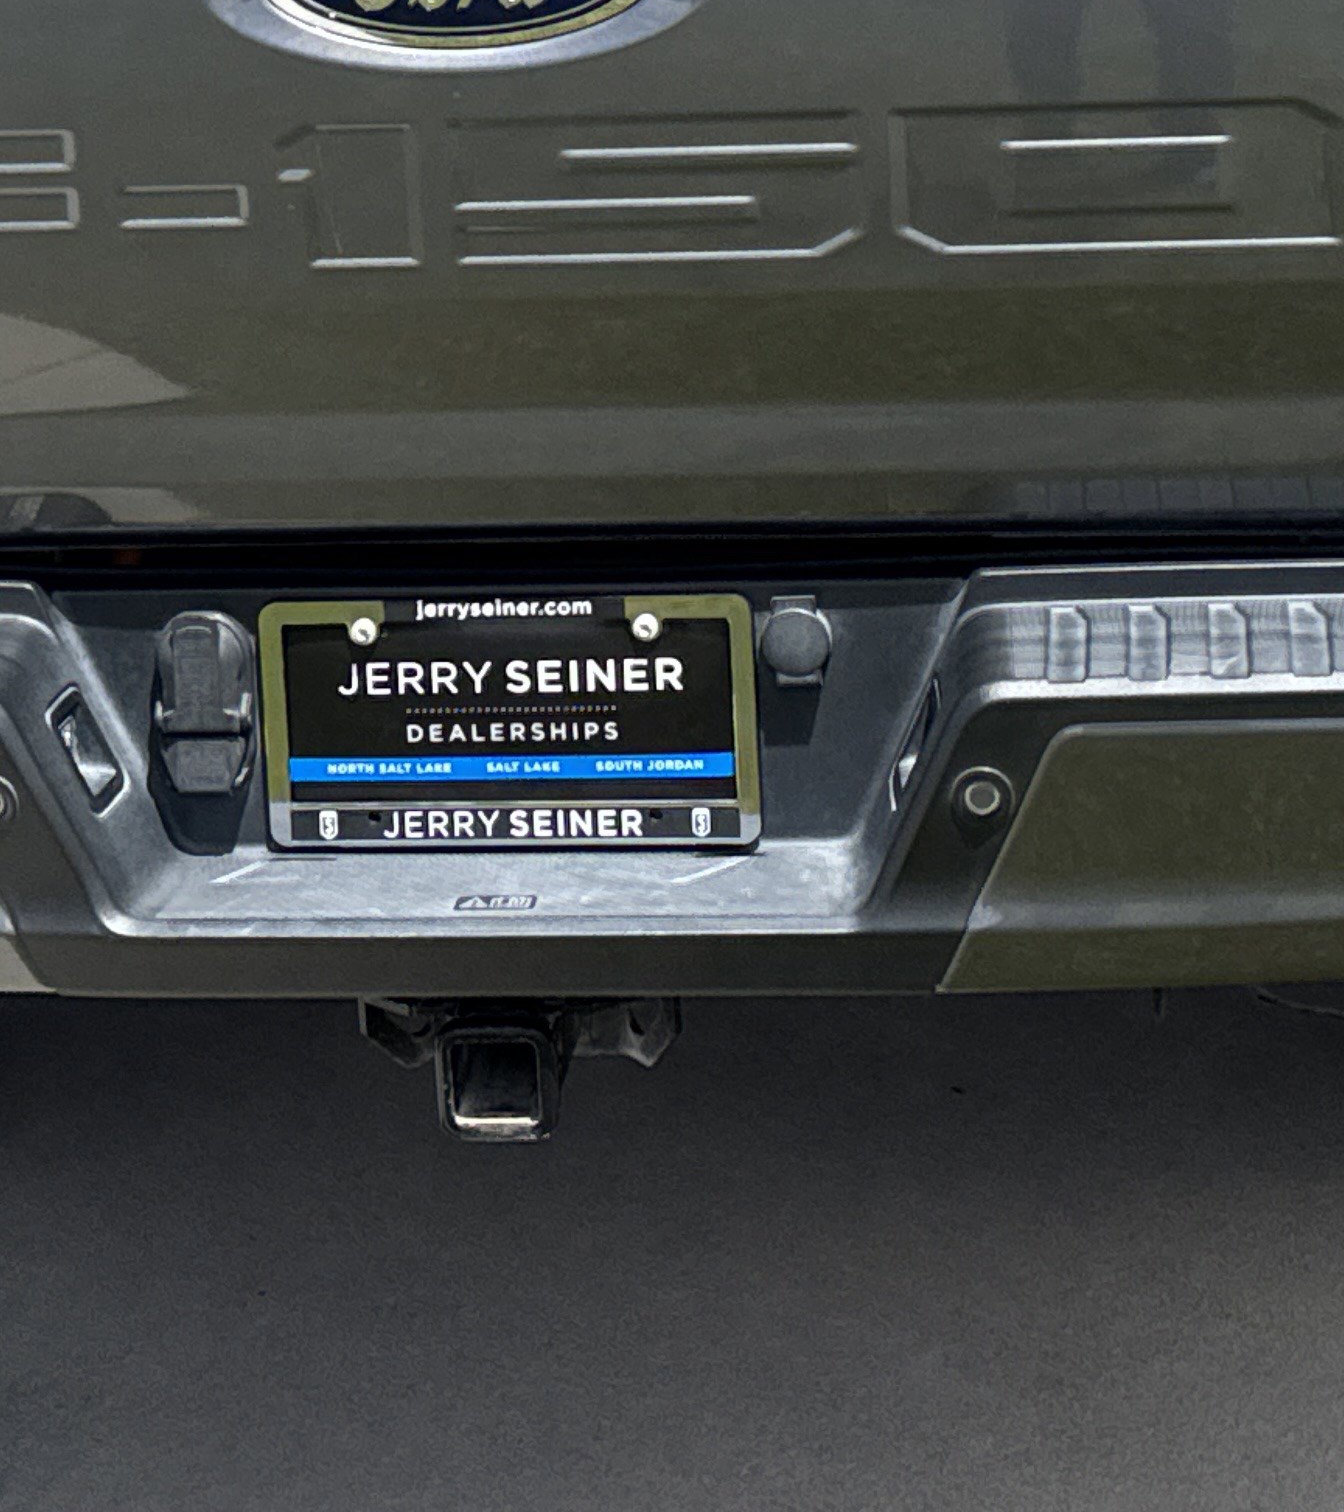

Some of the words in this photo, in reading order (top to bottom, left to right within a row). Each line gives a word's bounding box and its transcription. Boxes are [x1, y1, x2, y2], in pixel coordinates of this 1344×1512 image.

[415, 598, 593, 621] jerryseiner.com
[337, 659, 494, 697] JERRY
[504, 656, 685, 694] SEINER
[406, 721, 619, 744] DEALERSHIPS
[327, 762, 375, 775] NORTH
[379, 762, 412, 775] SALT
[416, 761, 453, 774] LAKE
[486, 760, 519, 773] SALT
[524, 760, 561, 773] LAKE
[595, 759, 644, 772] SOUTH
[647, 758, 705, 771] JORDAN
[382, 810, 499, 839] JERRY
[508, 808, 644, 838] SEINER
